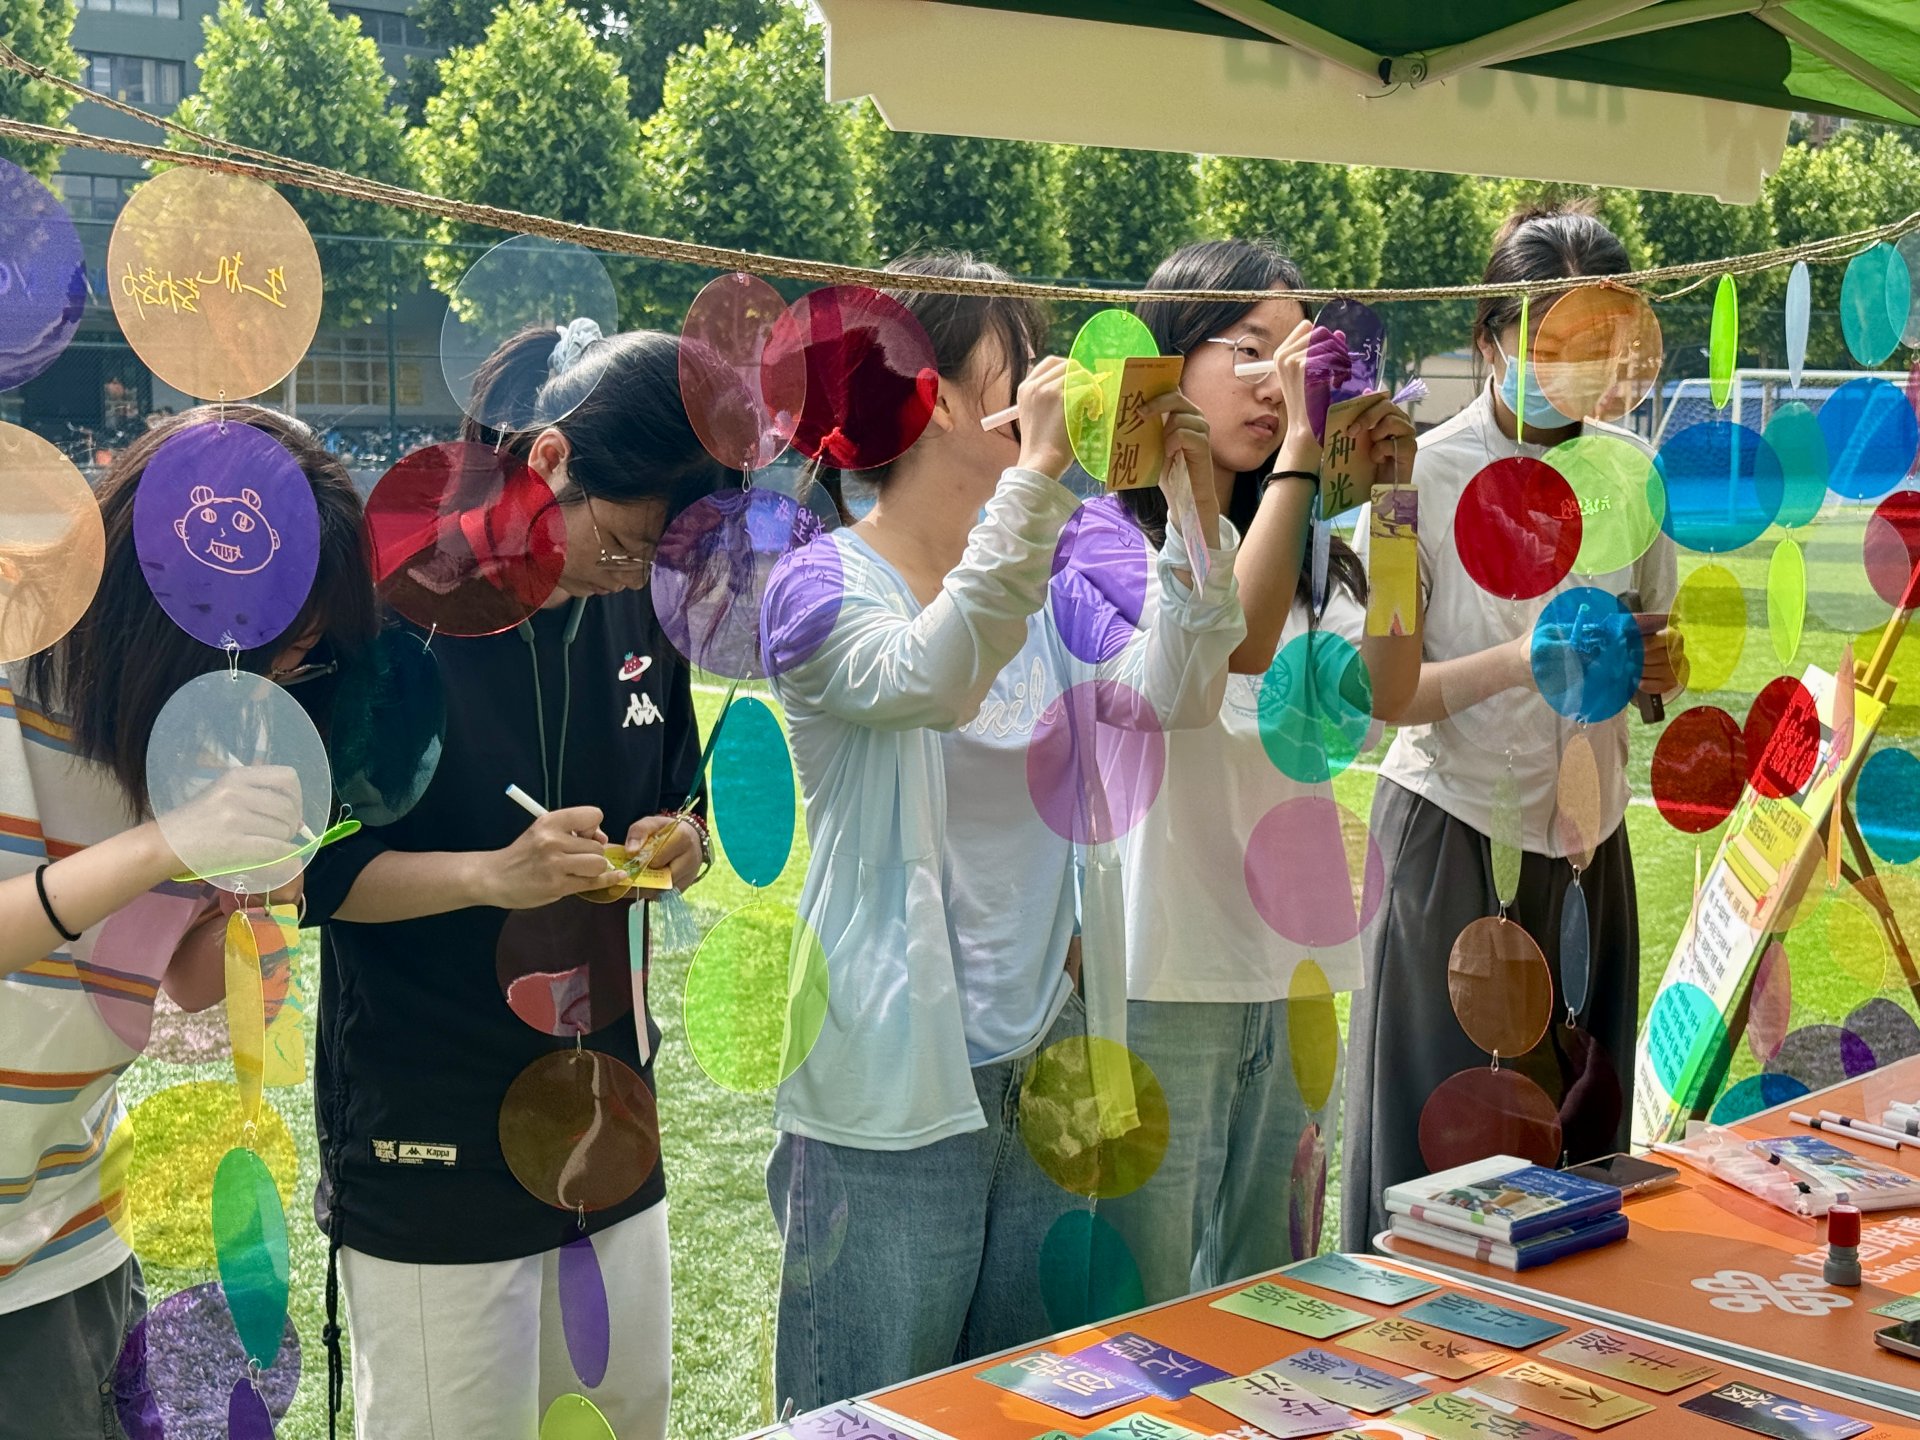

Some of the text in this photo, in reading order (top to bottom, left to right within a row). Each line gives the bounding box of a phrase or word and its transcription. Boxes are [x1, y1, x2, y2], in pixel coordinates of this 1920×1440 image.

[1111, 390, 1147, 488] 珍视
[1324, 425, 1356, 515] 种光
[426, 1148, 450, 1158] Kappa
[1239, 1282, 1348, 1321] 崭新
[1428, 1291, 1528, 1329] 启航
[1101, 1336, 1204, 1379] 无碍
[1363, 1320, 1470, 1360] 考验
[1566, 1329, 1686, 1371] 丰盛
[1010, 1352, 1116, 1397] 创造
[1288, 1350, 1394, 1391] 共舞
[1502, 1364, 1622, 1409] 不息
[1229, 1372, 1335, 1417] 专注
[1711, 1383, 1829, 1424] 心窗
[1417, 1396, 1542, 1439] 悦读
